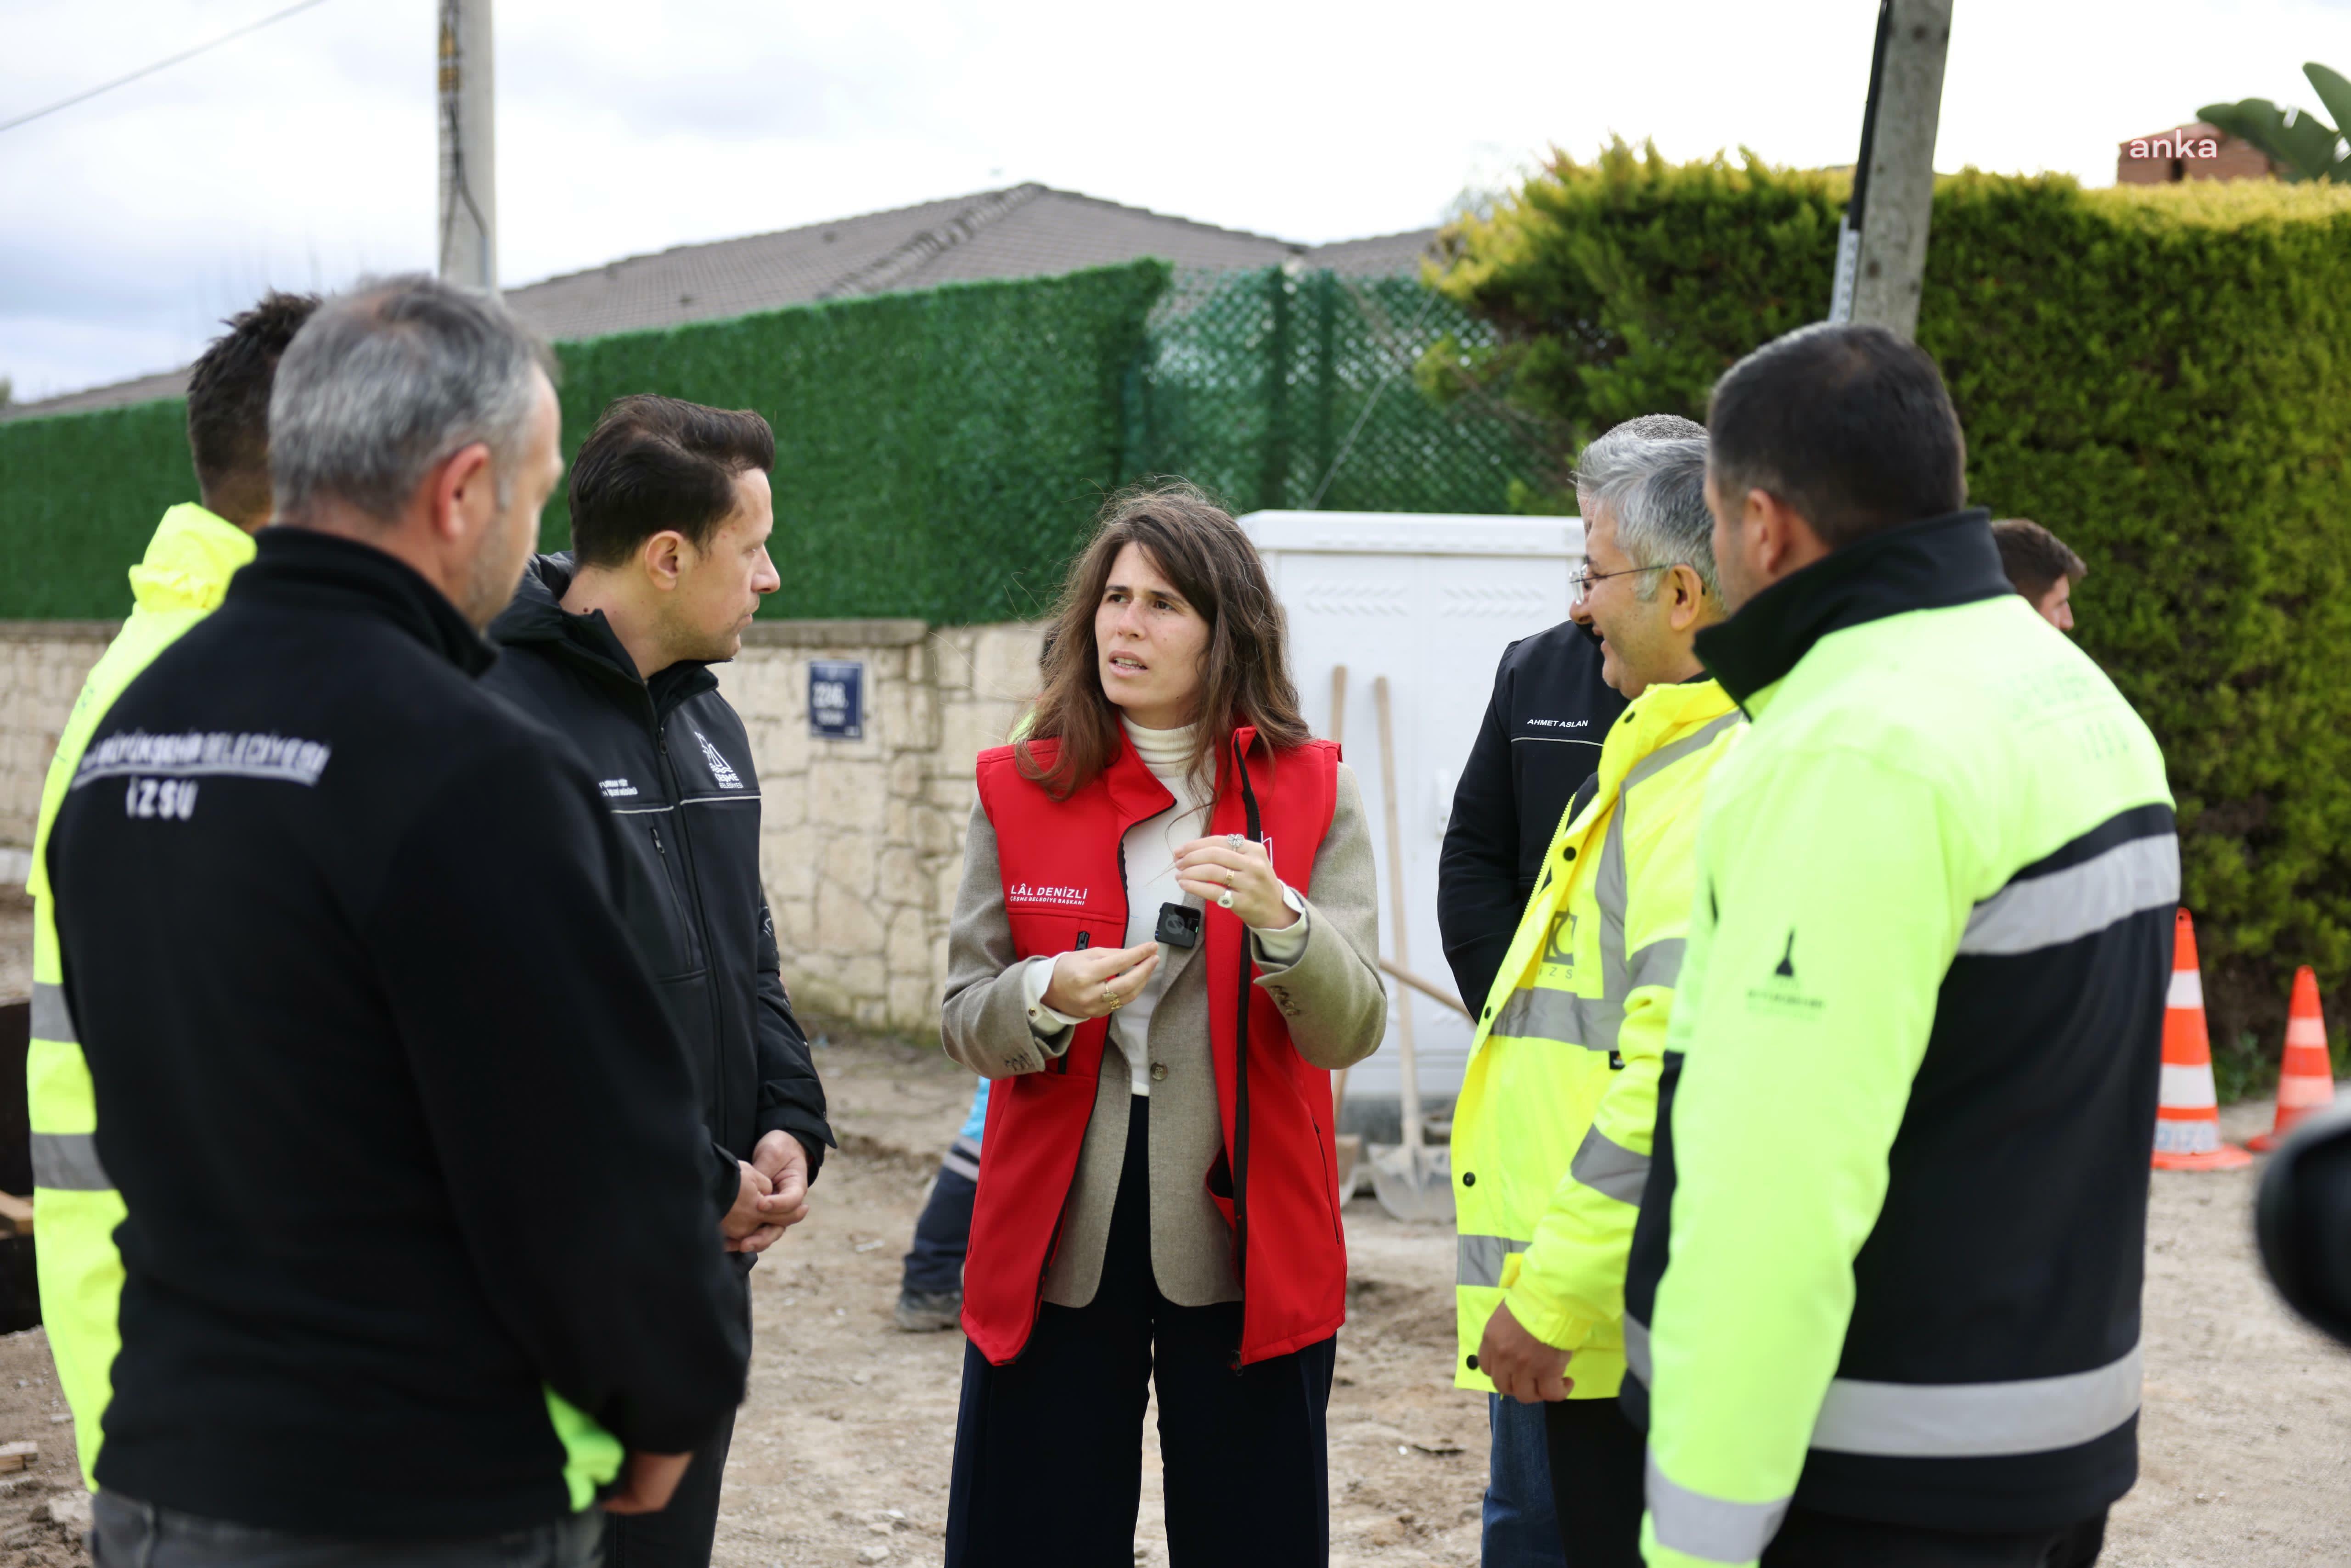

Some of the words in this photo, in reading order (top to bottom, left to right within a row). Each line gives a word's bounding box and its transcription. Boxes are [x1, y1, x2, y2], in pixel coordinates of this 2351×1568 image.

[714, 773, 739, 782] ÇEŞME
[1011, 883, 1034, 895] LÂL
[1036, 887, 1088, 899] DENİZLİ
